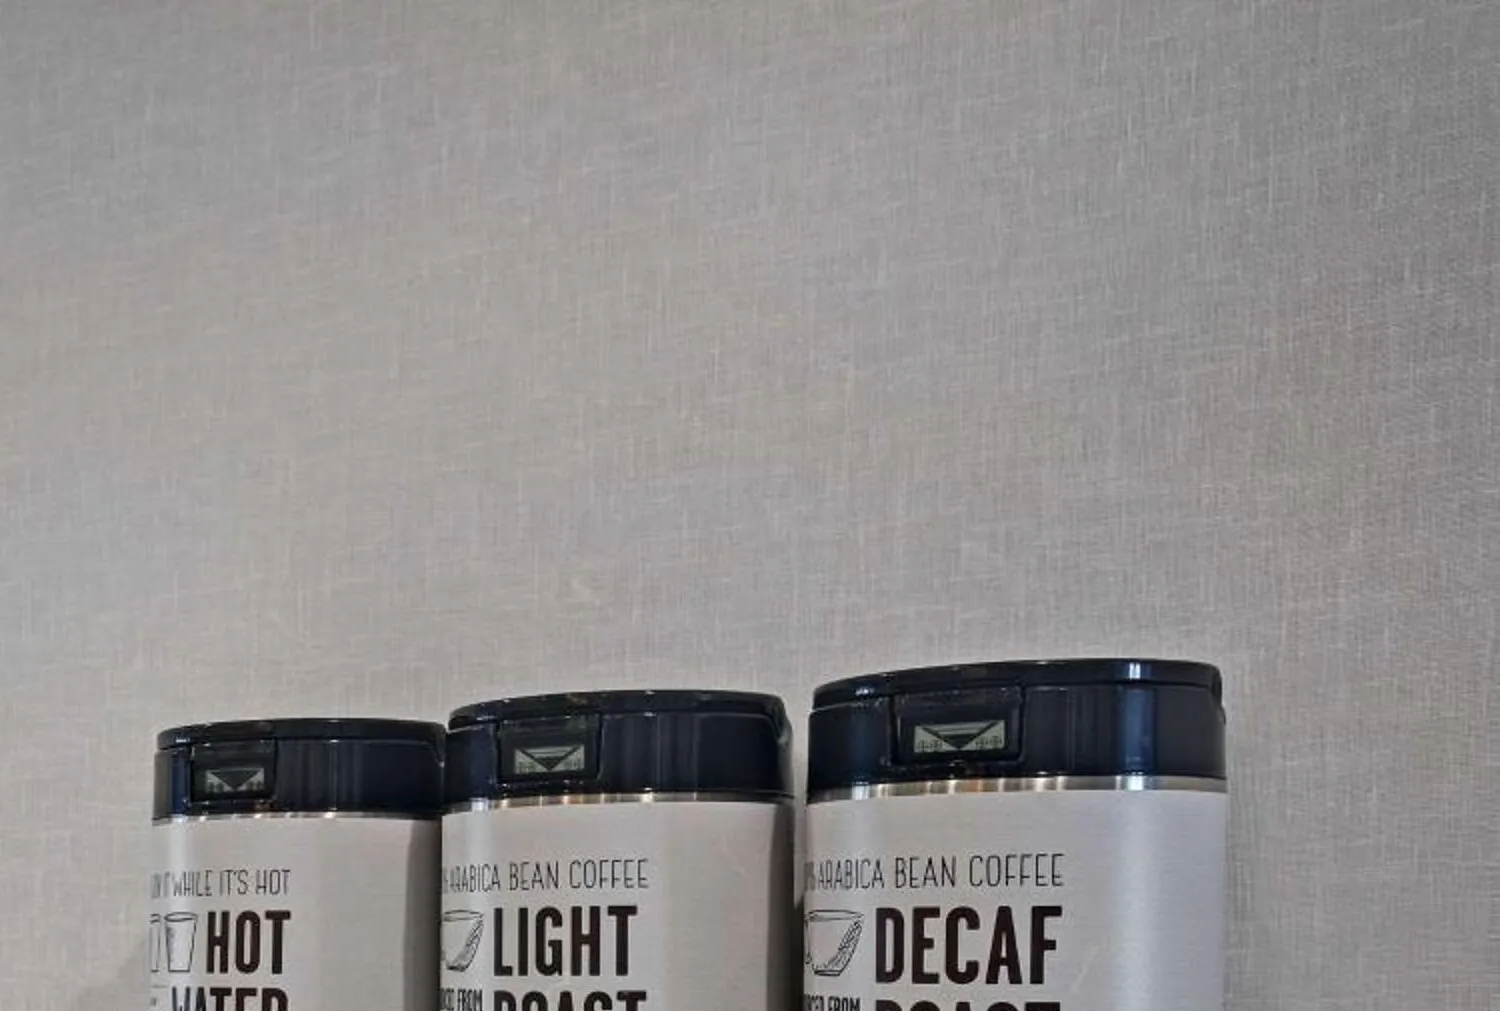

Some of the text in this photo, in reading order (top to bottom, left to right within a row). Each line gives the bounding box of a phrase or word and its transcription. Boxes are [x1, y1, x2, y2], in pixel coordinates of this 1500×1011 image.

[172, 870, 213, 897] WHILE
[219, 869, 249, 896] IT'S
[255, 869, 292, 896] HOT
[509, 860, 559, 891] BEAN
[569, 858, 649, 889] COFFEE
[819, 858, 885, 890] ARABICA
[895, 856, 956, 889] BEAN
[969, 853, 1065, 887] COFFEE
[205, 910, 292, 975] HOT
[493, 905, 637, 977] LIGHT
[875, 905, 1062, 985] DECAF
